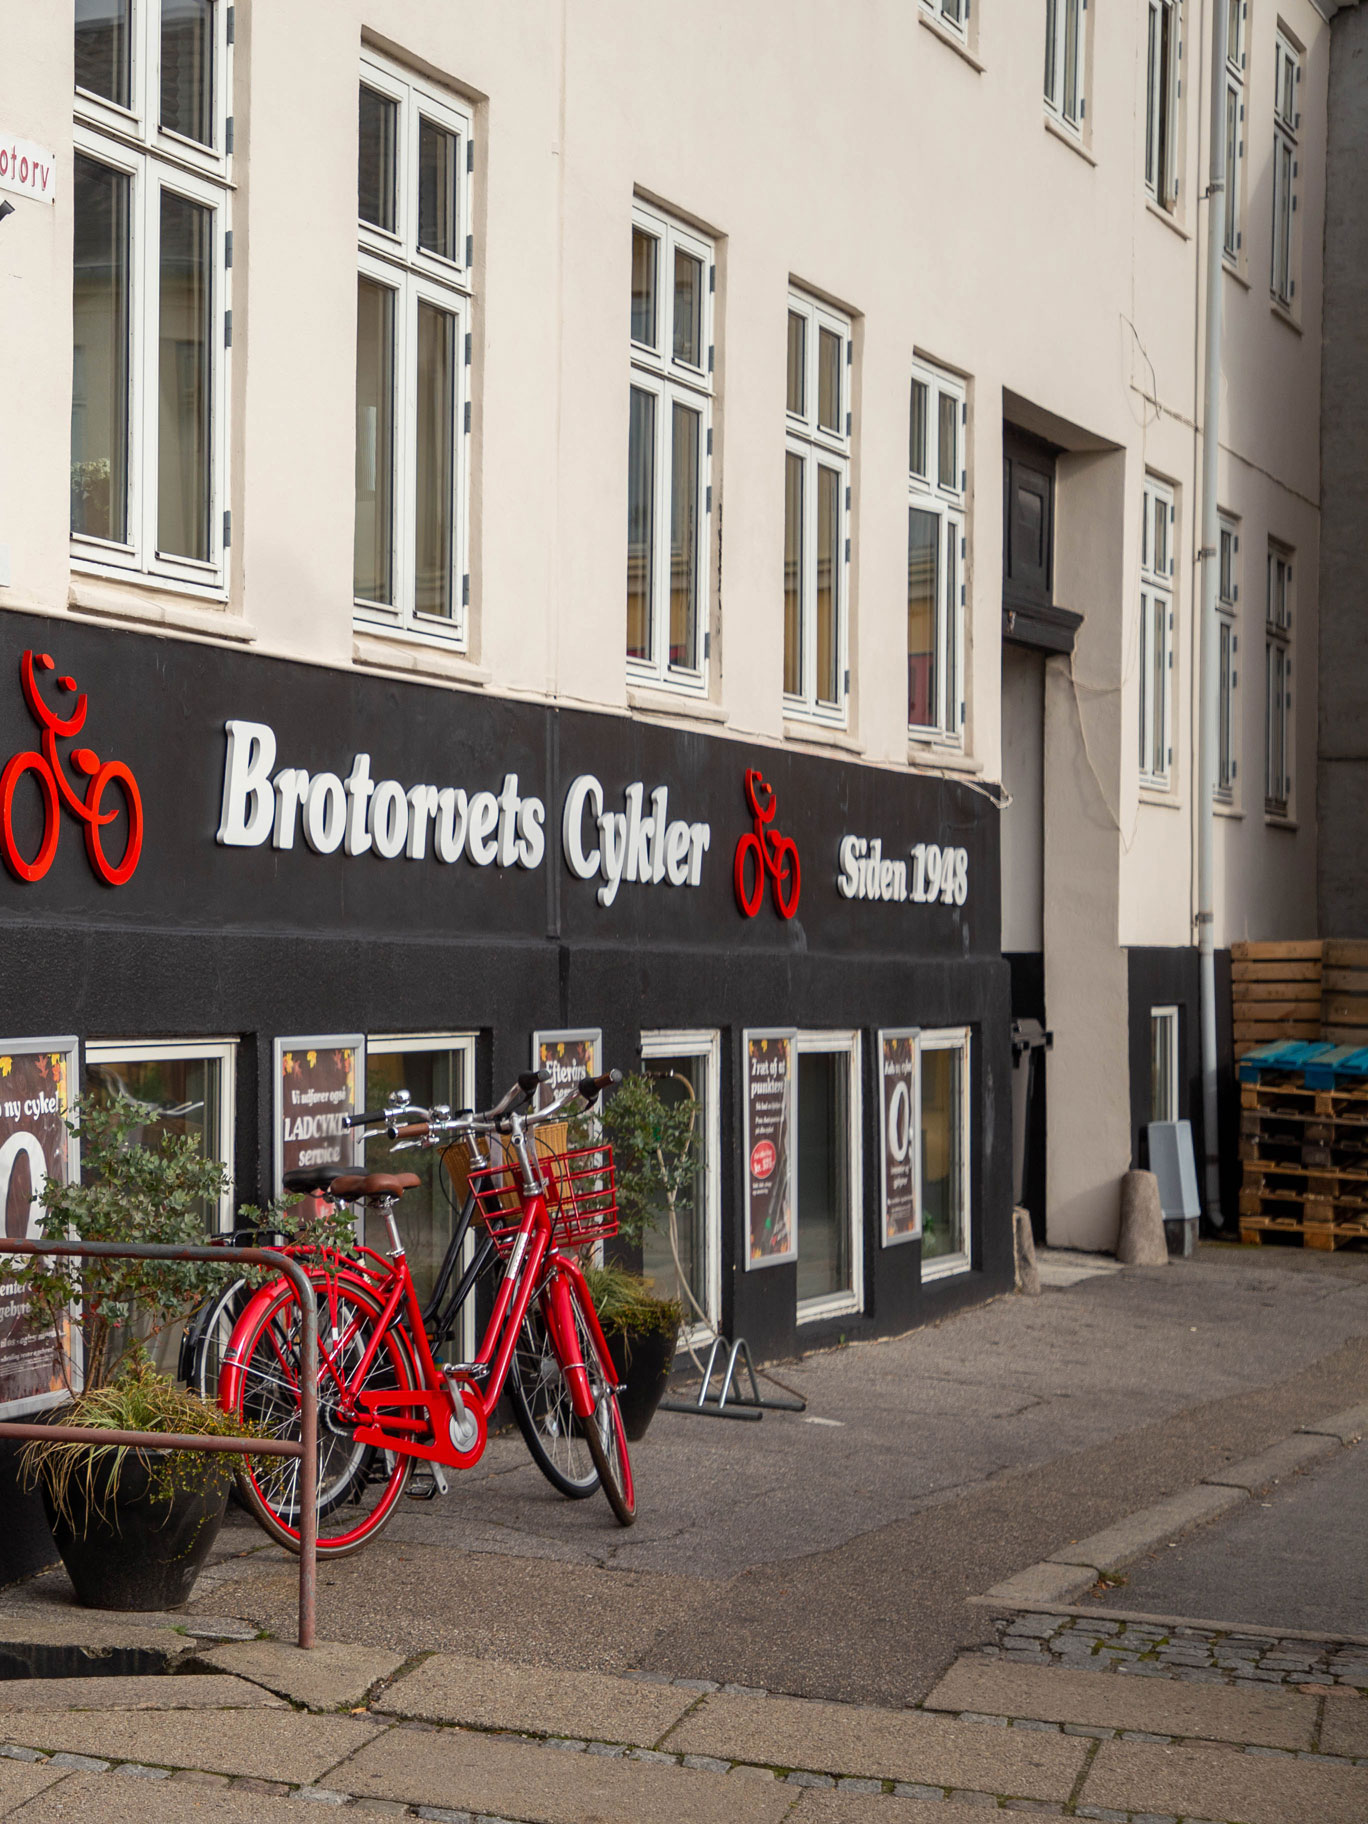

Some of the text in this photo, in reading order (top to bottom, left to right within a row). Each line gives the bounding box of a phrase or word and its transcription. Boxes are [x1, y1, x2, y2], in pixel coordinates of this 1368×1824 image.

[217, 719, 710, 907] Brotorvets Cykler
[837, 835, 969, 906] Siden 1948
[4, 1100, 21, 1122] ny
[23, 1091, 59, 1120] cykel
[889, 1080, 909, 1162] 0
[298, 1142, 342, 1167] service
